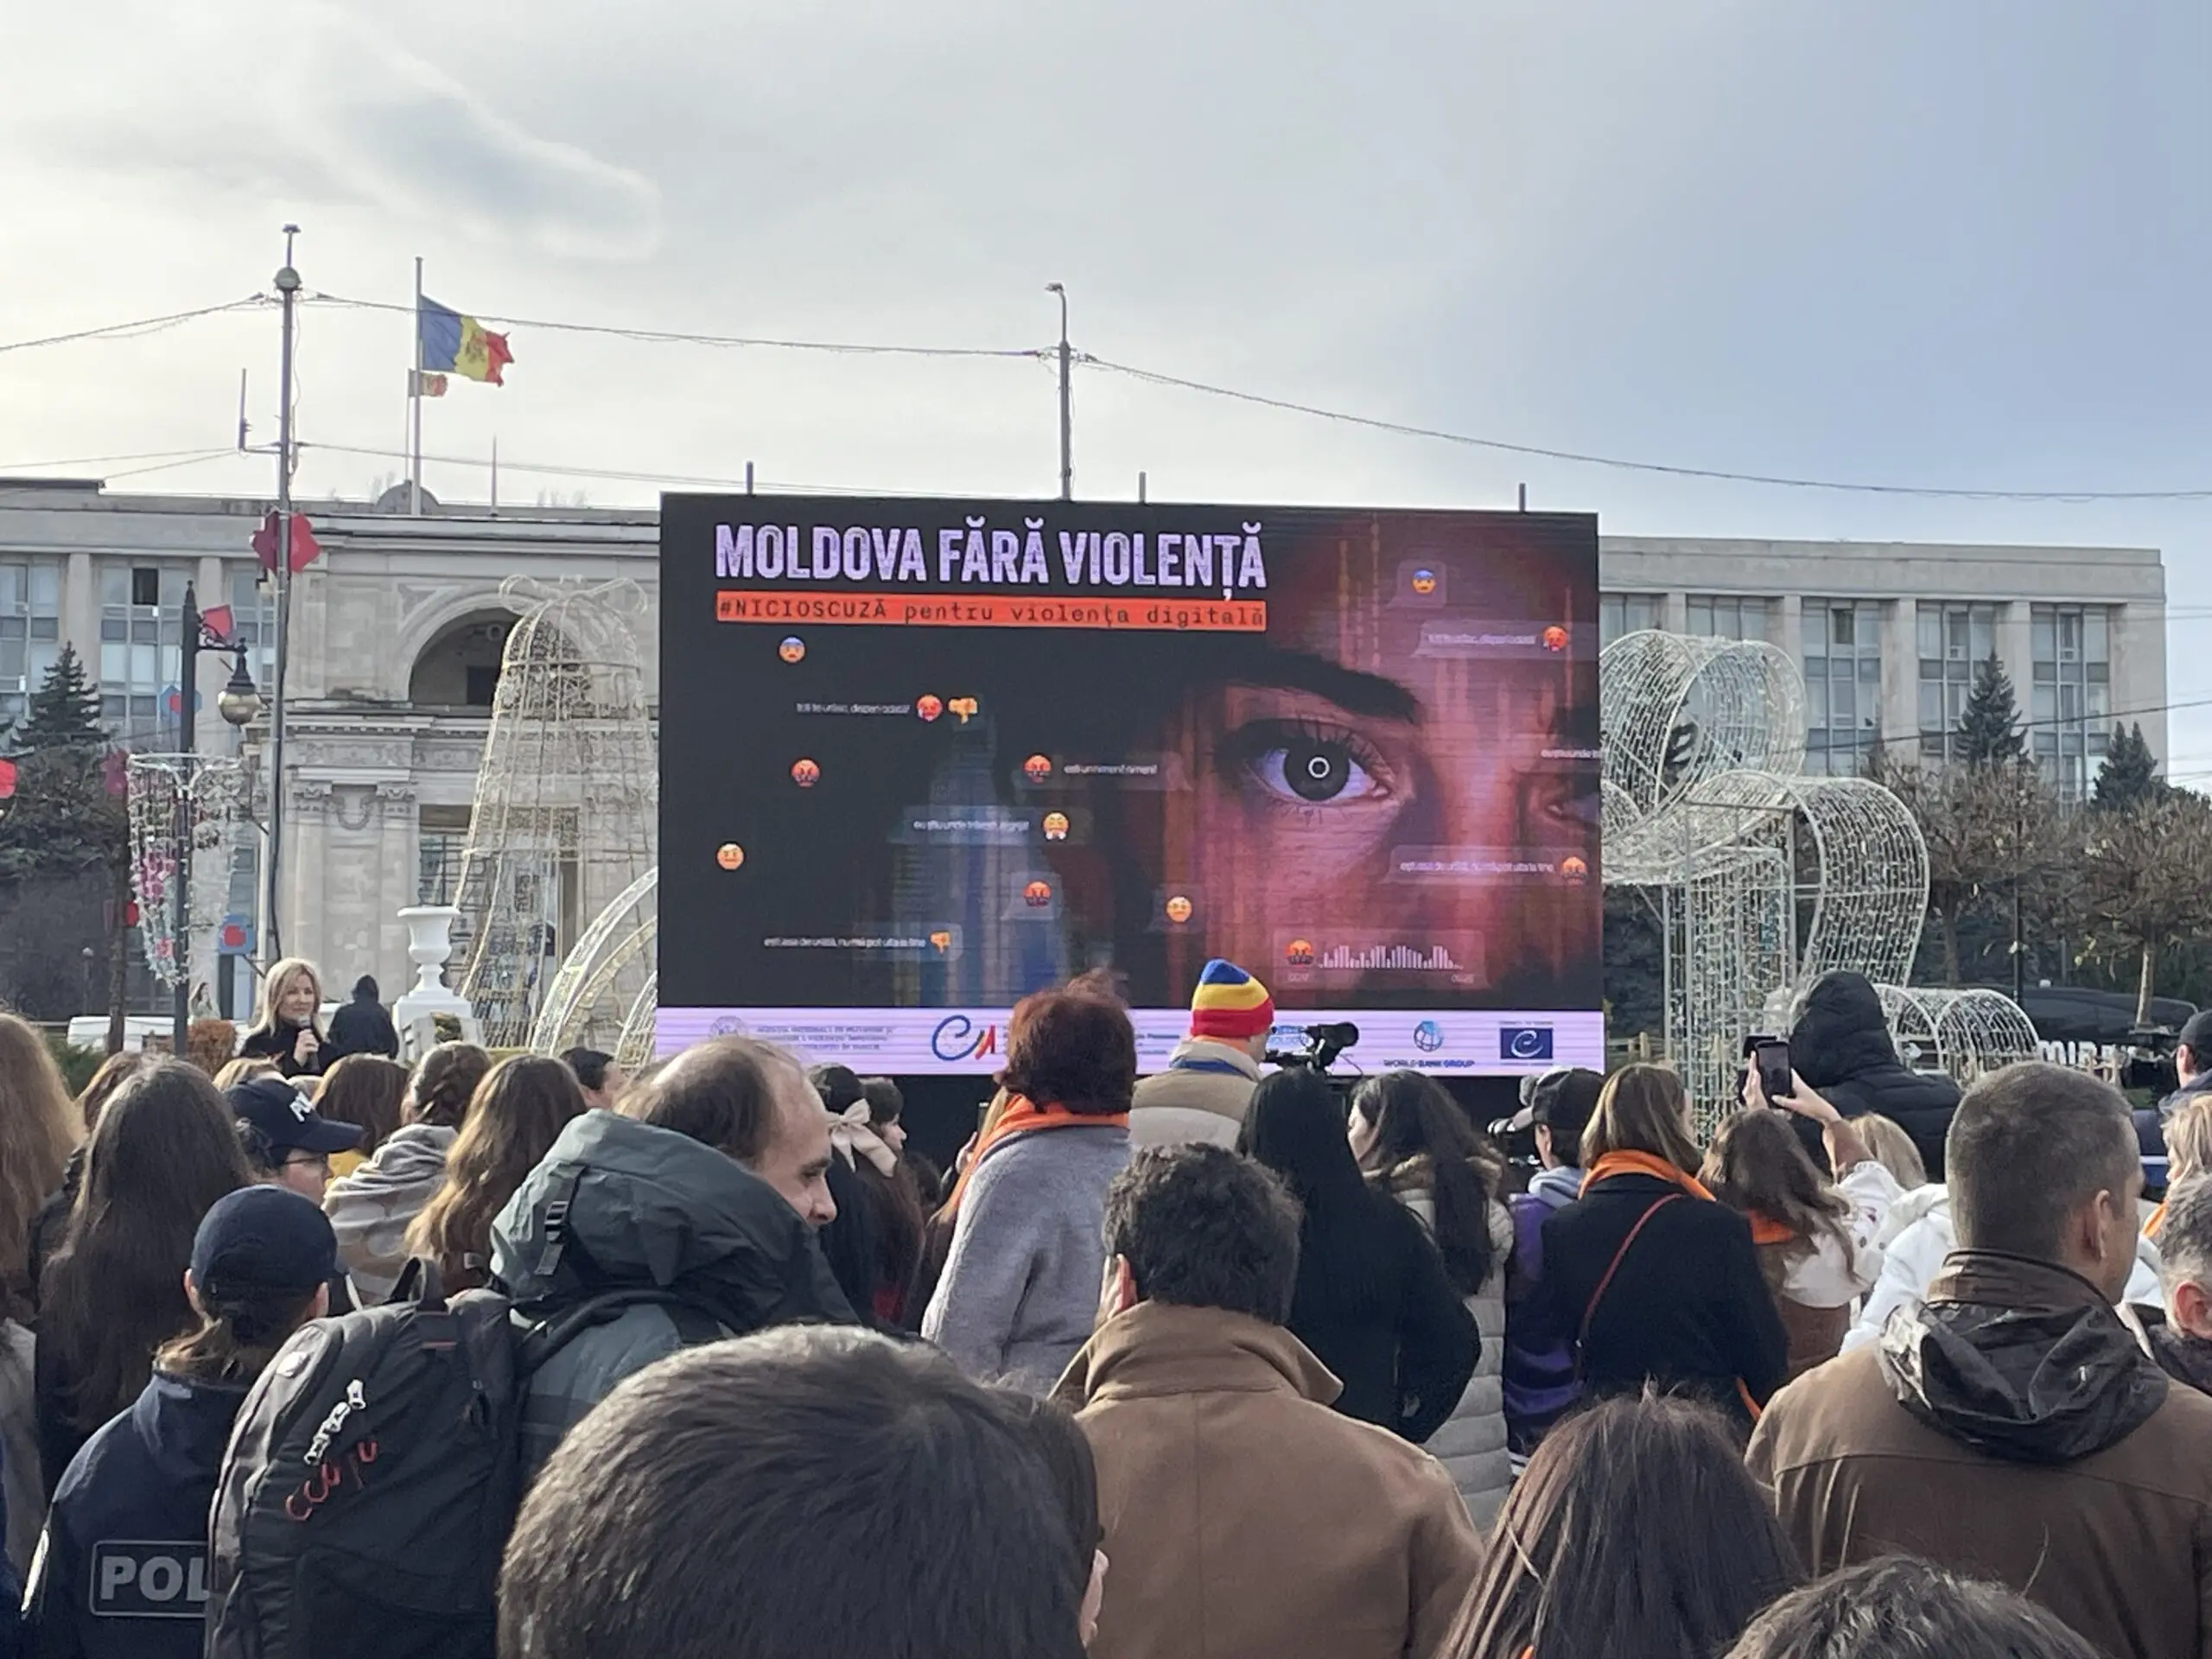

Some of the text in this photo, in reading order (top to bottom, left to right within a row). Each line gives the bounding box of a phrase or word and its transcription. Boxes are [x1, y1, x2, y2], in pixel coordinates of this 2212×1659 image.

[715, 515, 1268, 601] MOLDOVA FĂRĂ VIOLENȚĂ
[719, 598, 887, 619] #NICIOSCUZĂ
[906, 601, 991, 625] pentru
[1147, 606, 1263, 628] digitală
[99, 1555, 211, 1602] POL
